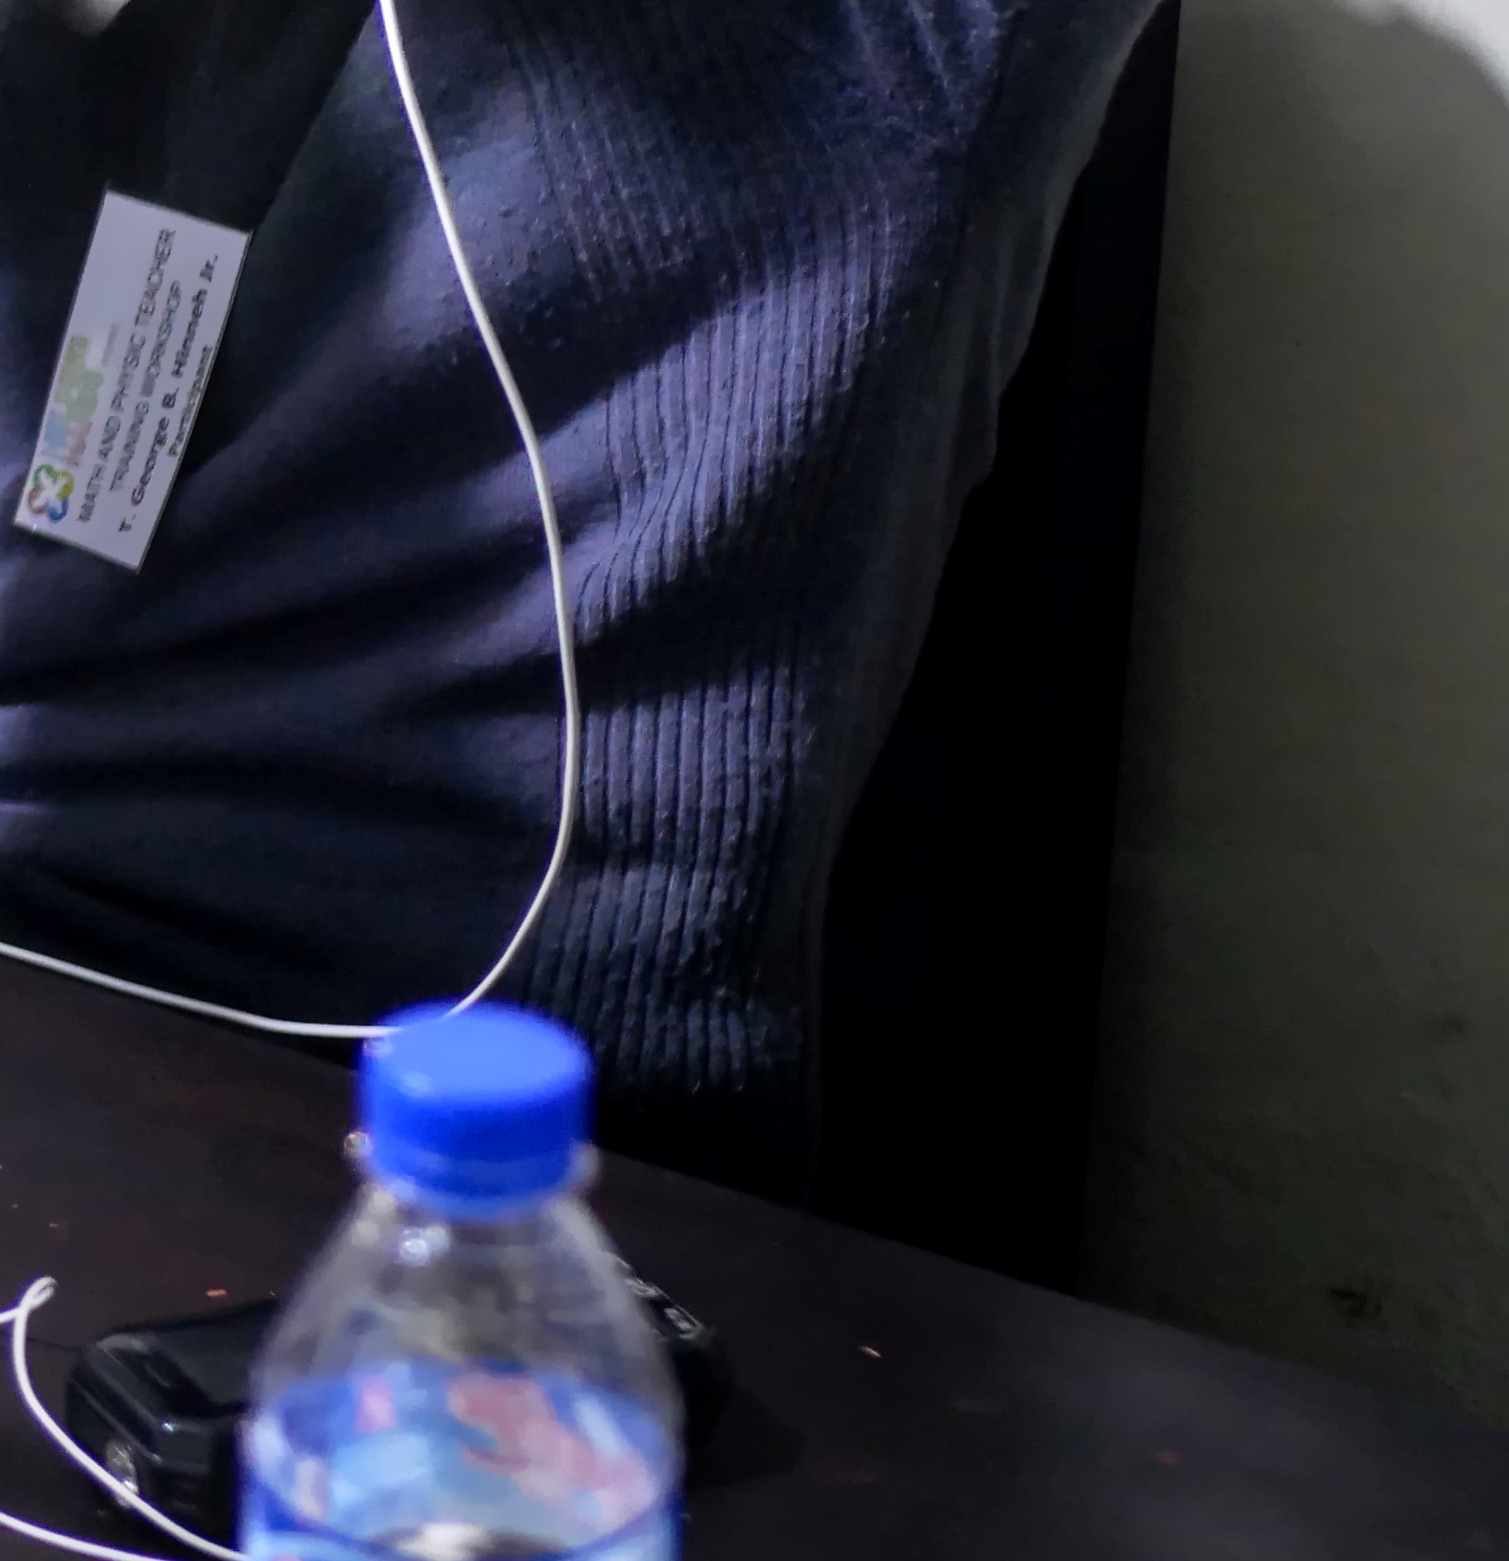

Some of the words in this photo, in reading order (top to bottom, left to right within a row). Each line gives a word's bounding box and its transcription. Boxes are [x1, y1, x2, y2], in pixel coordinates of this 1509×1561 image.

[135, 227, 177, 329] TEACHER
[109, 400, 148, 494] TRAINING
[129, 415, 171, 507] George
